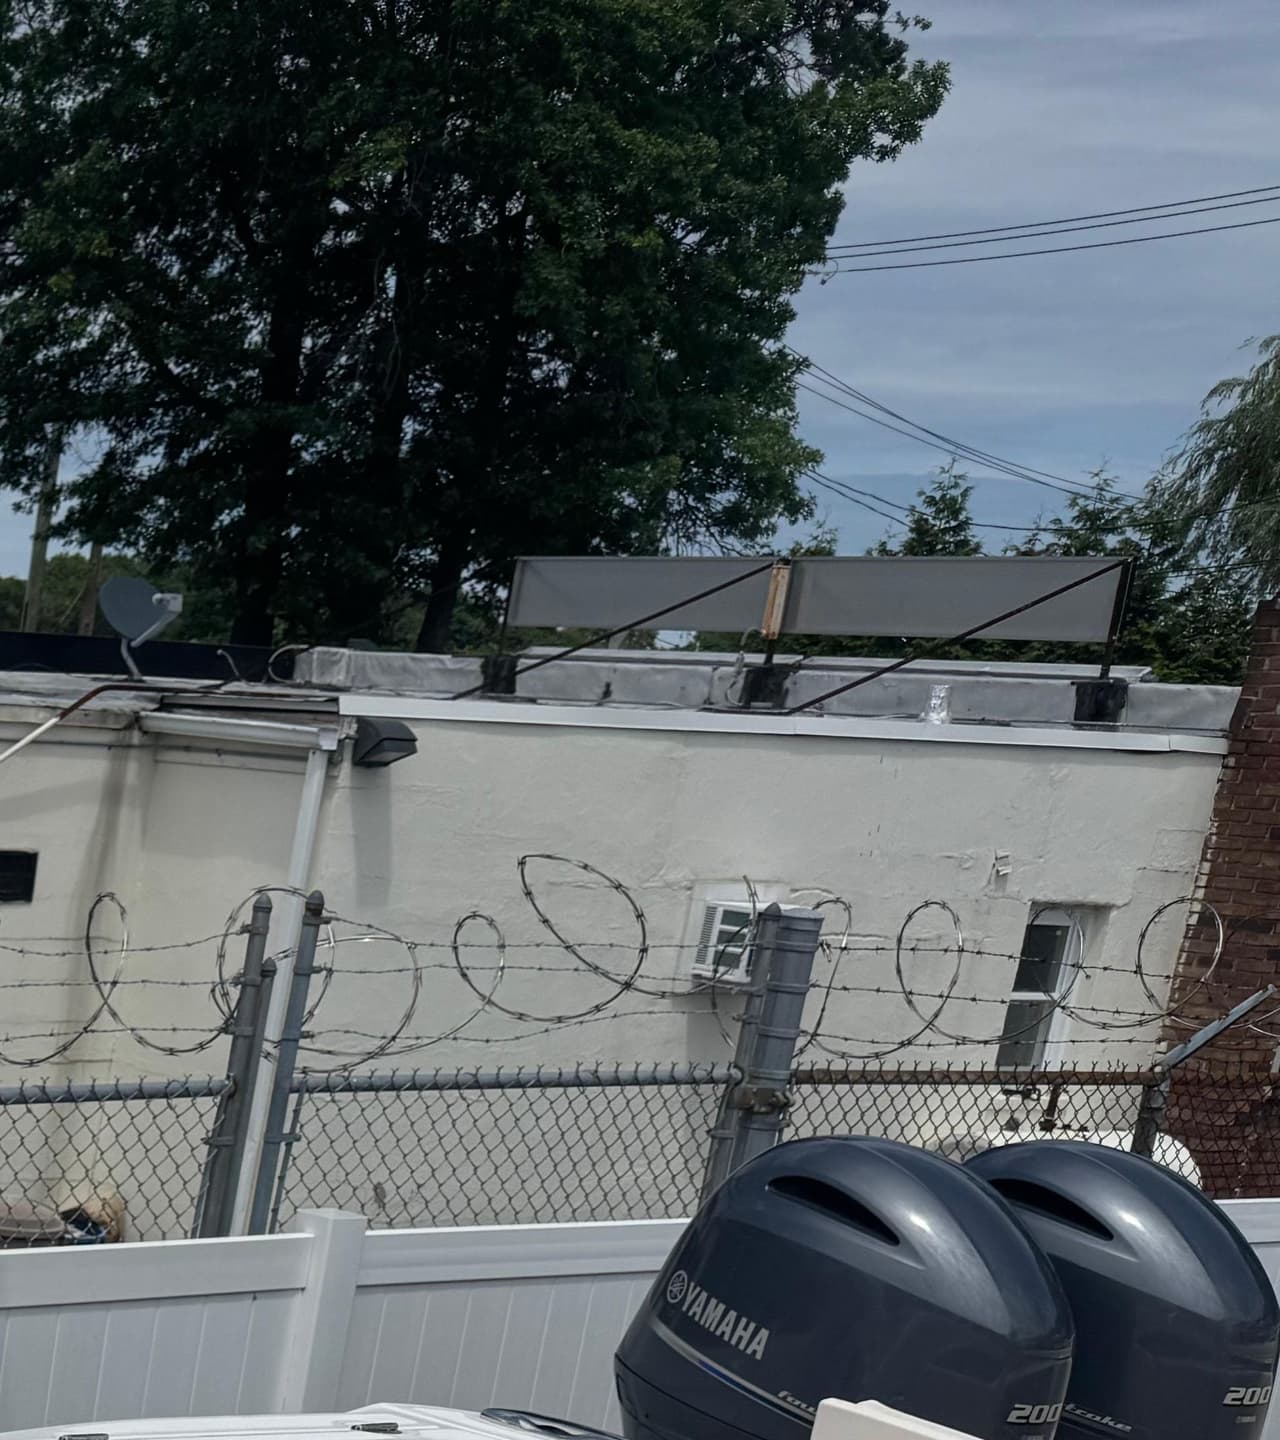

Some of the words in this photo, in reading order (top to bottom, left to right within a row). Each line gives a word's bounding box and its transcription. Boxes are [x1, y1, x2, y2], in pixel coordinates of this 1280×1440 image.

[681, 1281, 771, 1361] YAMAHA
[1221, 1385, 1272, 1406] 200
[1006, 1402, 1063, 1424] 200
